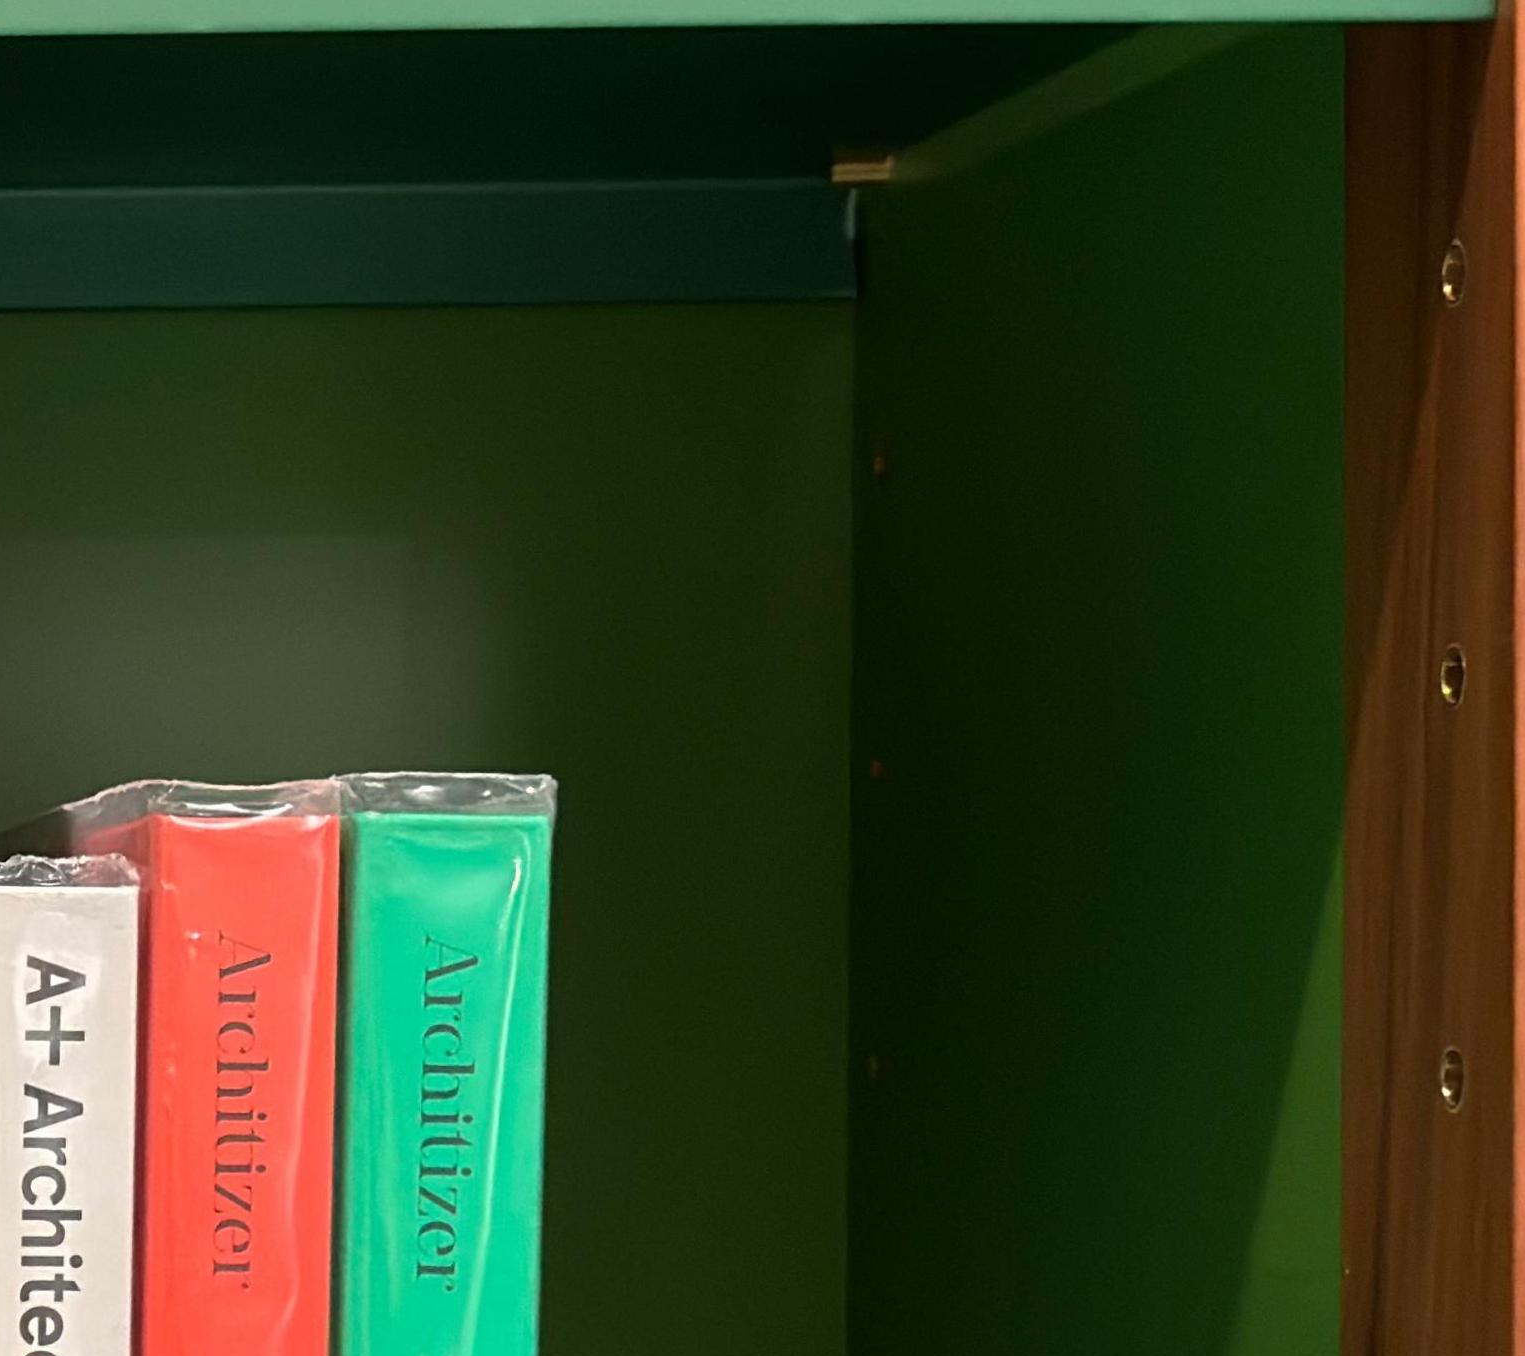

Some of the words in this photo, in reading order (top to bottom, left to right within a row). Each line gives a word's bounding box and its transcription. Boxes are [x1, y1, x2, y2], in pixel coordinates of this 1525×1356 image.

[23, 954, 87, 1067] A+
[211, 930, 272, 1290] Architizer
[415, 935, 480, 1293] Architizer
